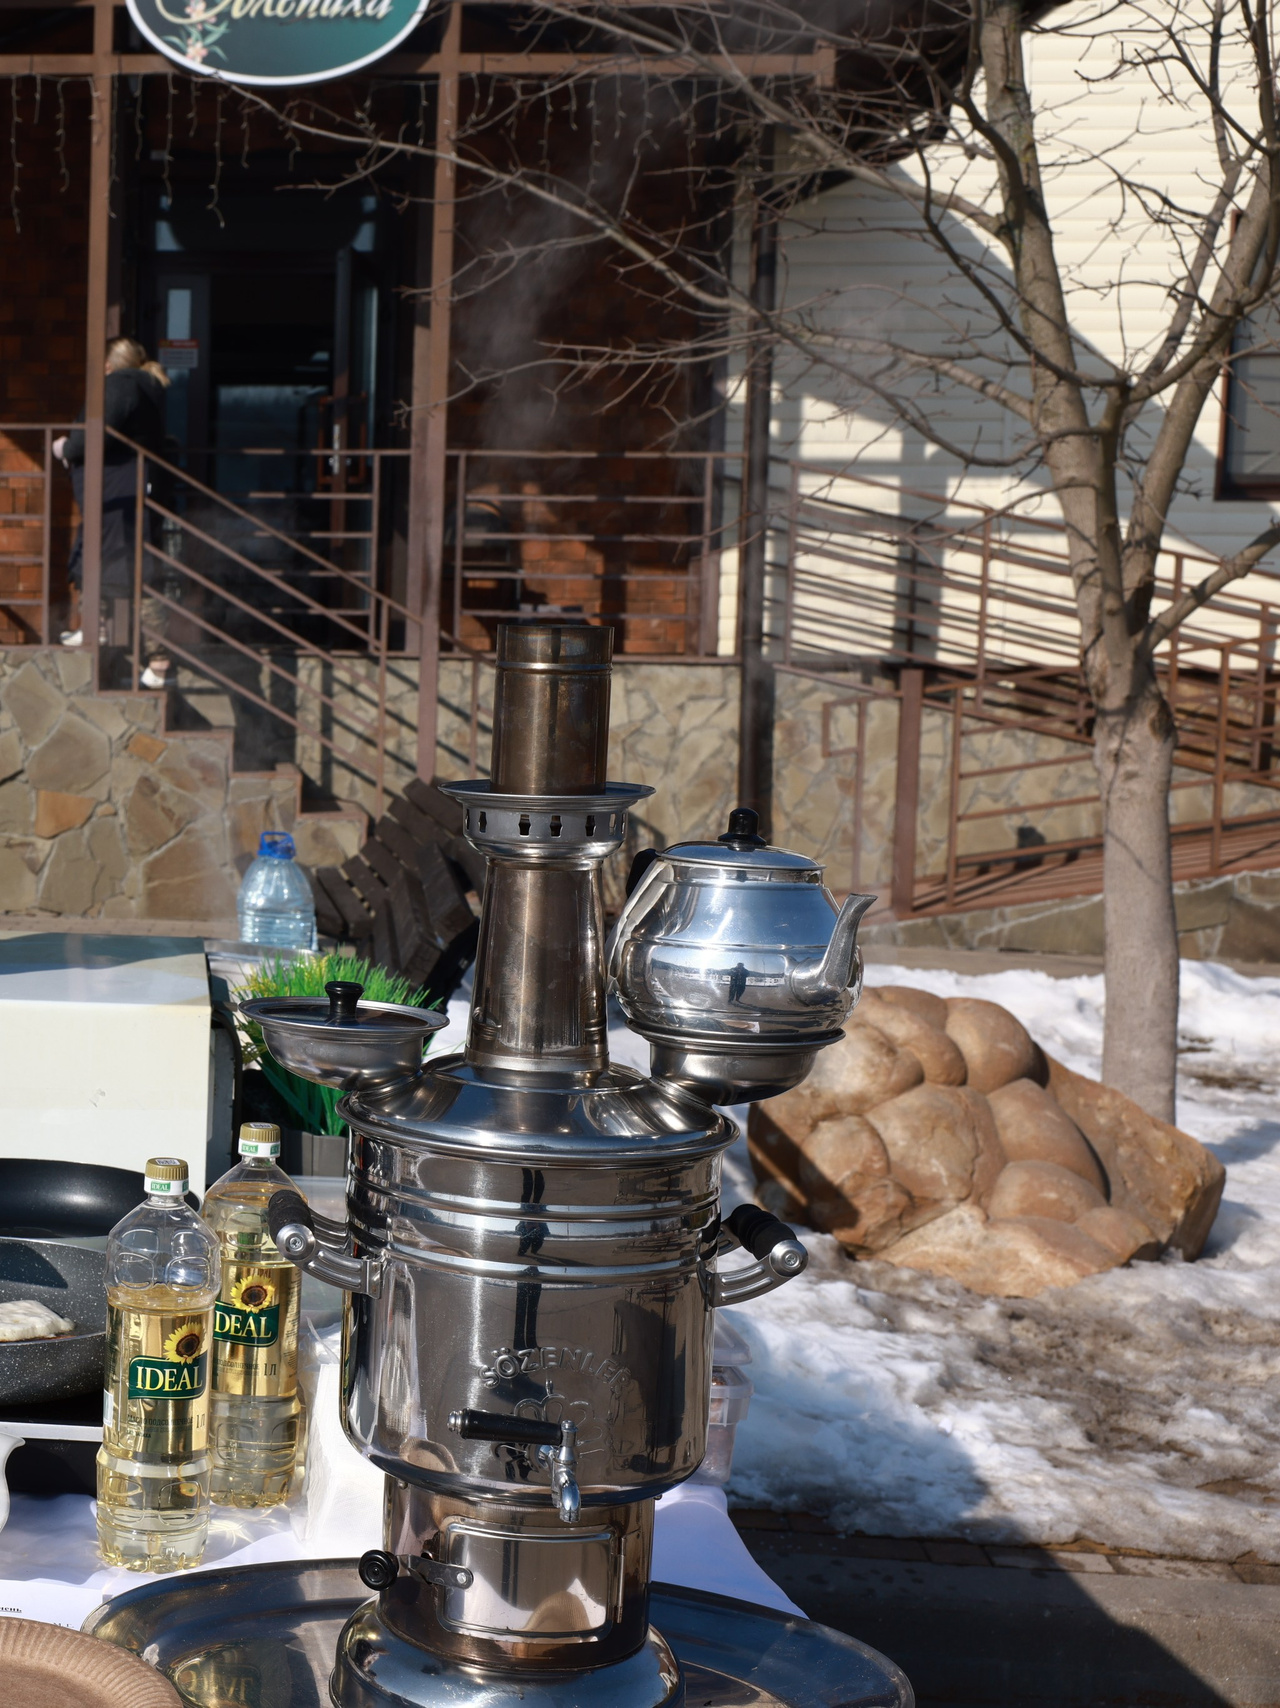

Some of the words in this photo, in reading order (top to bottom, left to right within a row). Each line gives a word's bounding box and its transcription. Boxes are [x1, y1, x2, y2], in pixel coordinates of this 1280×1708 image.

[151, 1183, 170, 1191] IDEAL
[215, 1310, 272, 1338] DEAL
[135, 1365, 203, 1391] IDEAL
